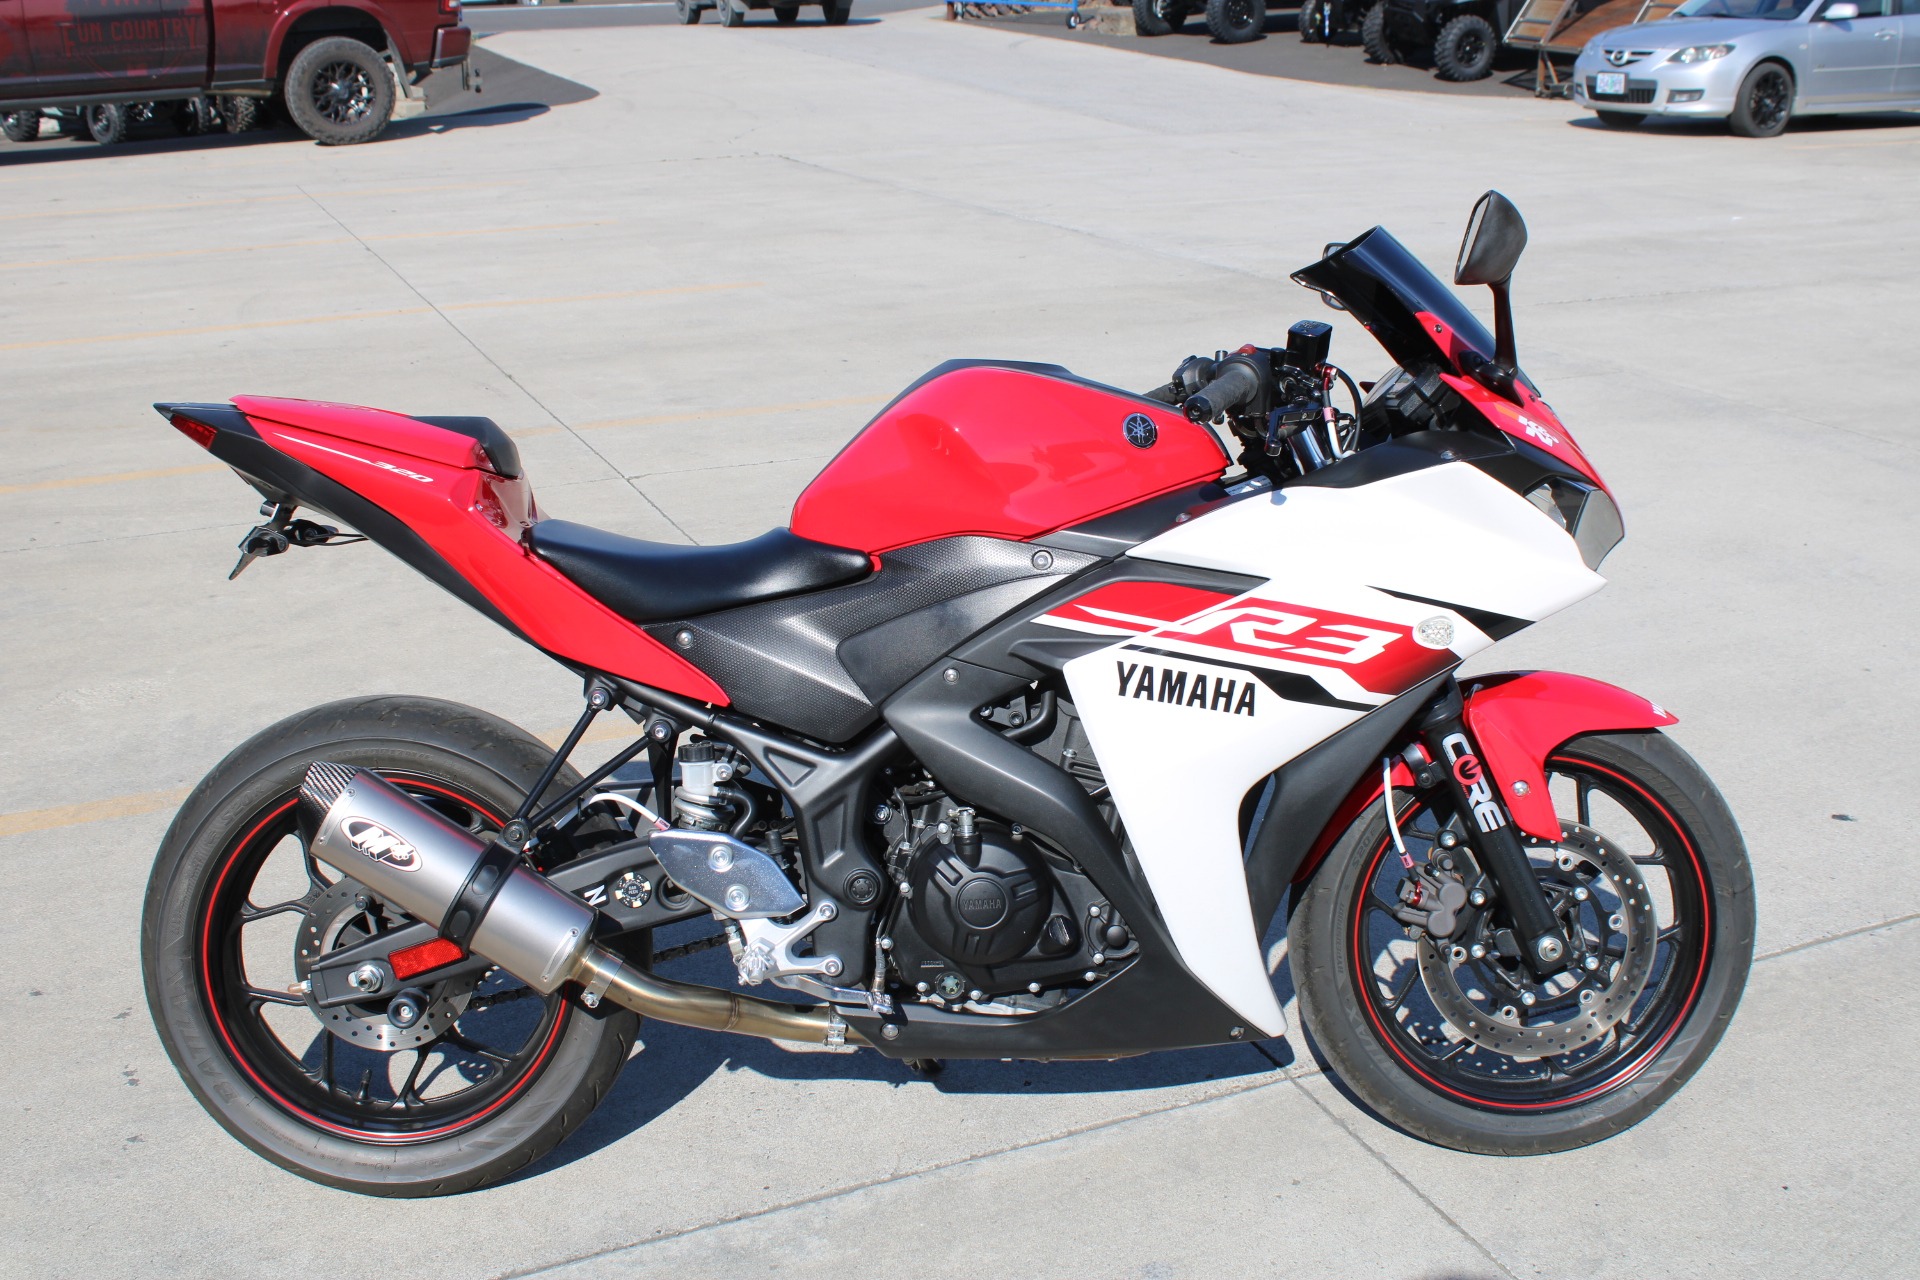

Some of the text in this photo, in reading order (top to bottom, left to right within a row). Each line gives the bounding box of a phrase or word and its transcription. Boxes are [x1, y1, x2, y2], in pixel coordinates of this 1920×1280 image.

[111, 16, 197, 49] COUNTRY
[1202, 606, 1404, 665] R3
[1116, 660, 1256, 717] YAMAHA
[962, 898, 1002, 911] YAMAHA
